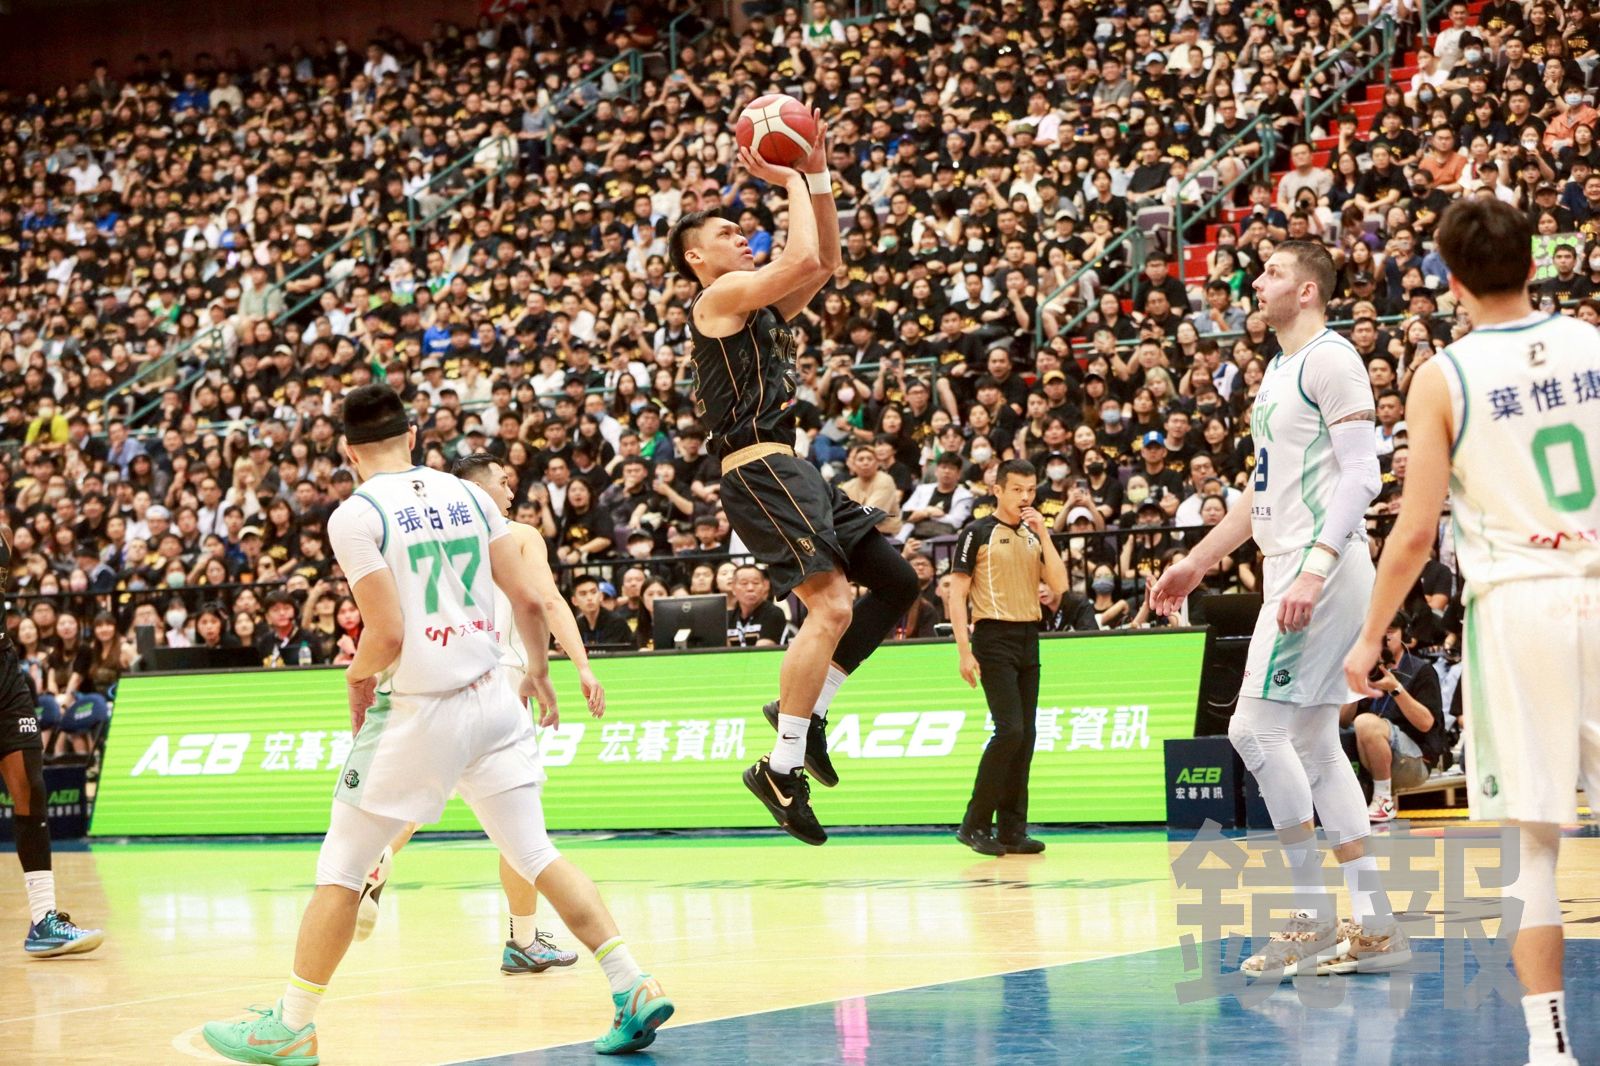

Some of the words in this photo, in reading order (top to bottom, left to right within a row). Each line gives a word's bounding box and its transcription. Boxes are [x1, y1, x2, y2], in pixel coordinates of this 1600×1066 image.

[1531, 422, 1596, 513] 0
[395, 501, 473, 534] 張伯維
[408, 536, 481, 615] 77
[130, 733, 251, 777] AEB
[260, 731, 354, 771] 宏碁資
[598, 718, 746, 762] 宏碁資訊
[826, 710, 966, 758] AEB
[984, 704, 1149, 751] 碁資訊
[1176, 767, 1222, 784] AEB
